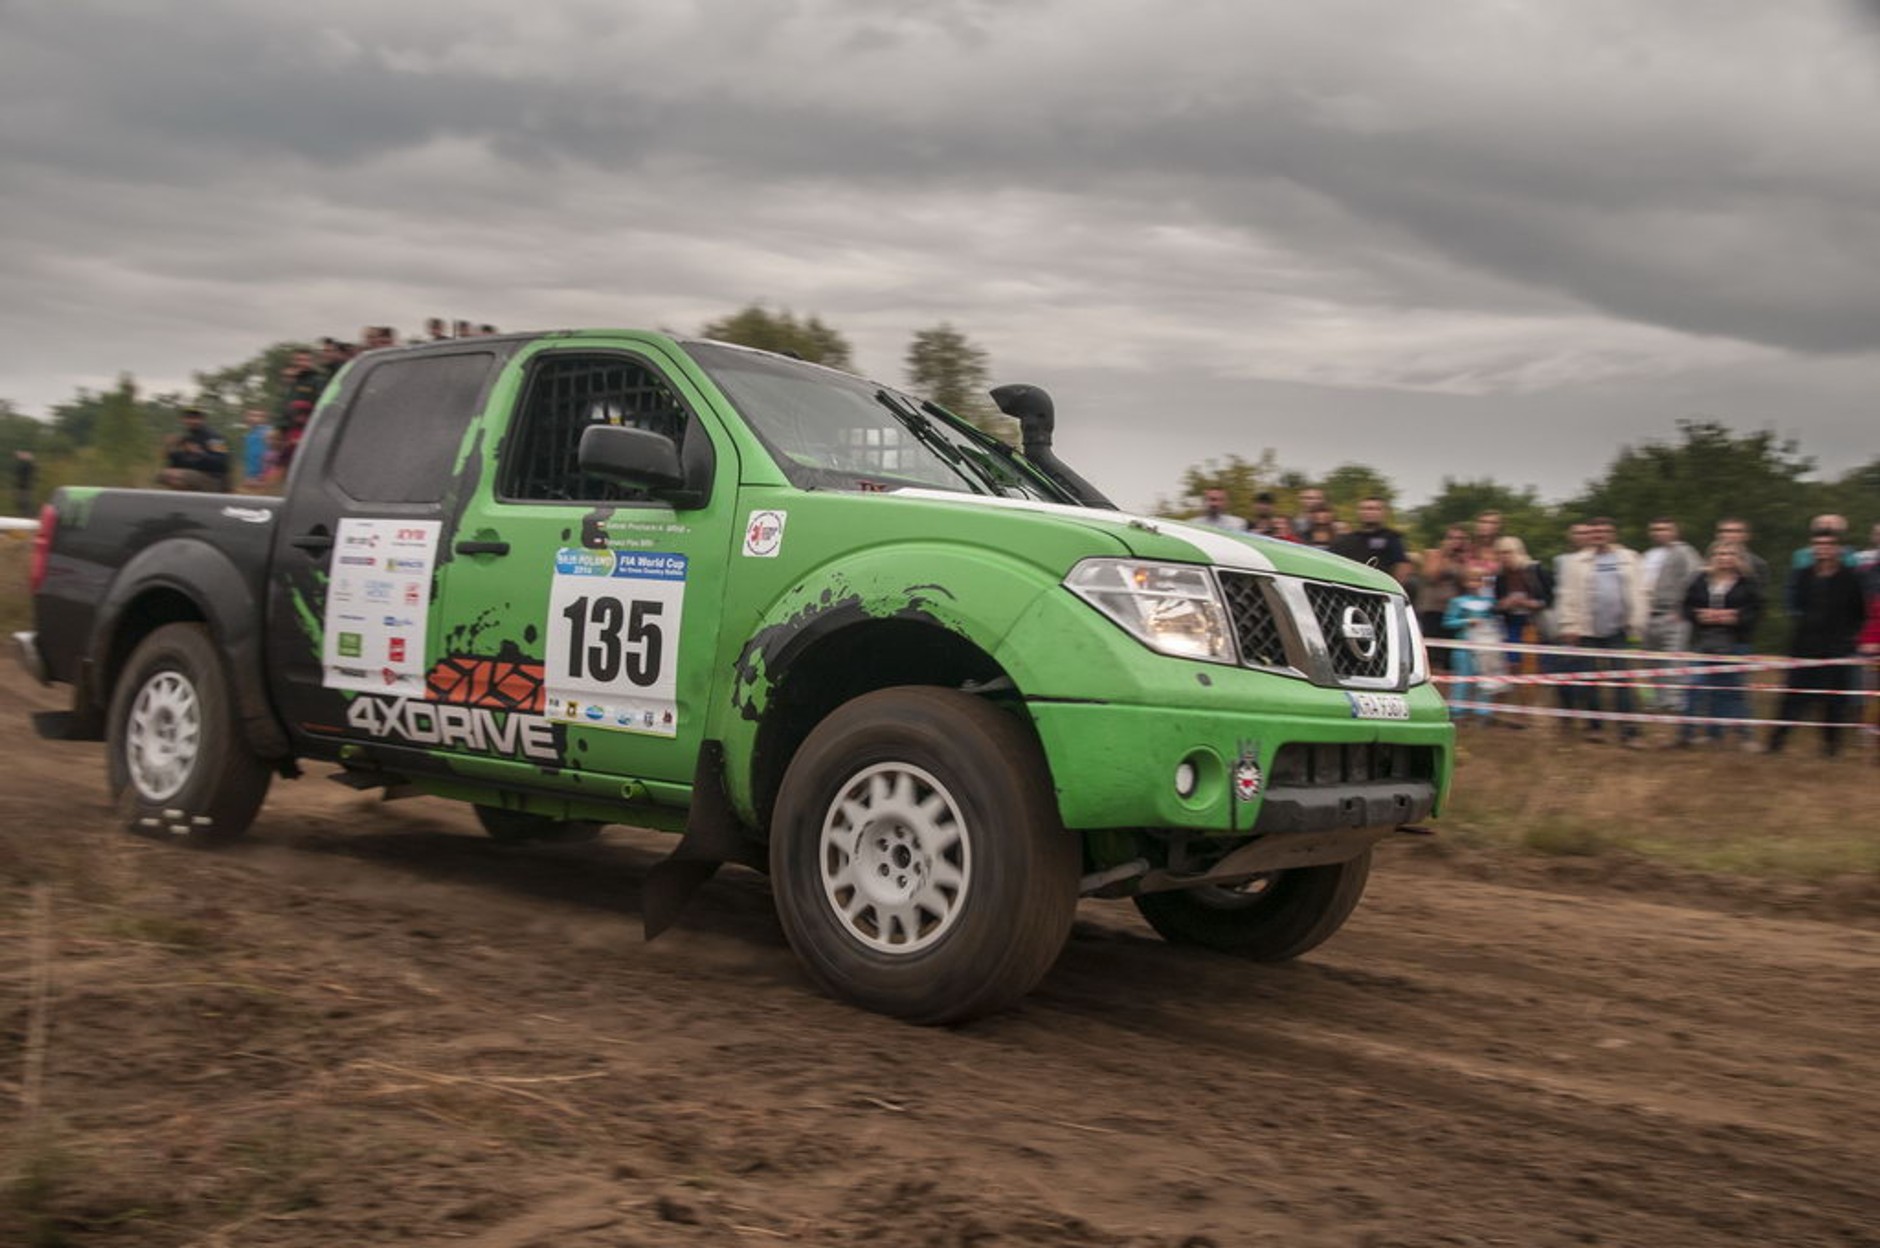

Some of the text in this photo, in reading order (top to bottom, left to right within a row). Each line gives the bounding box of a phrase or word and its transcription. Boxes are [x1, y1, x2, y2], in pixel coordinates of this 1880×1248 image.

[620, 556, 685, 571] FIA World Cup
[563, 596, 663, 687] 135
[347, 696, 559, 759] 4XDRIVE
